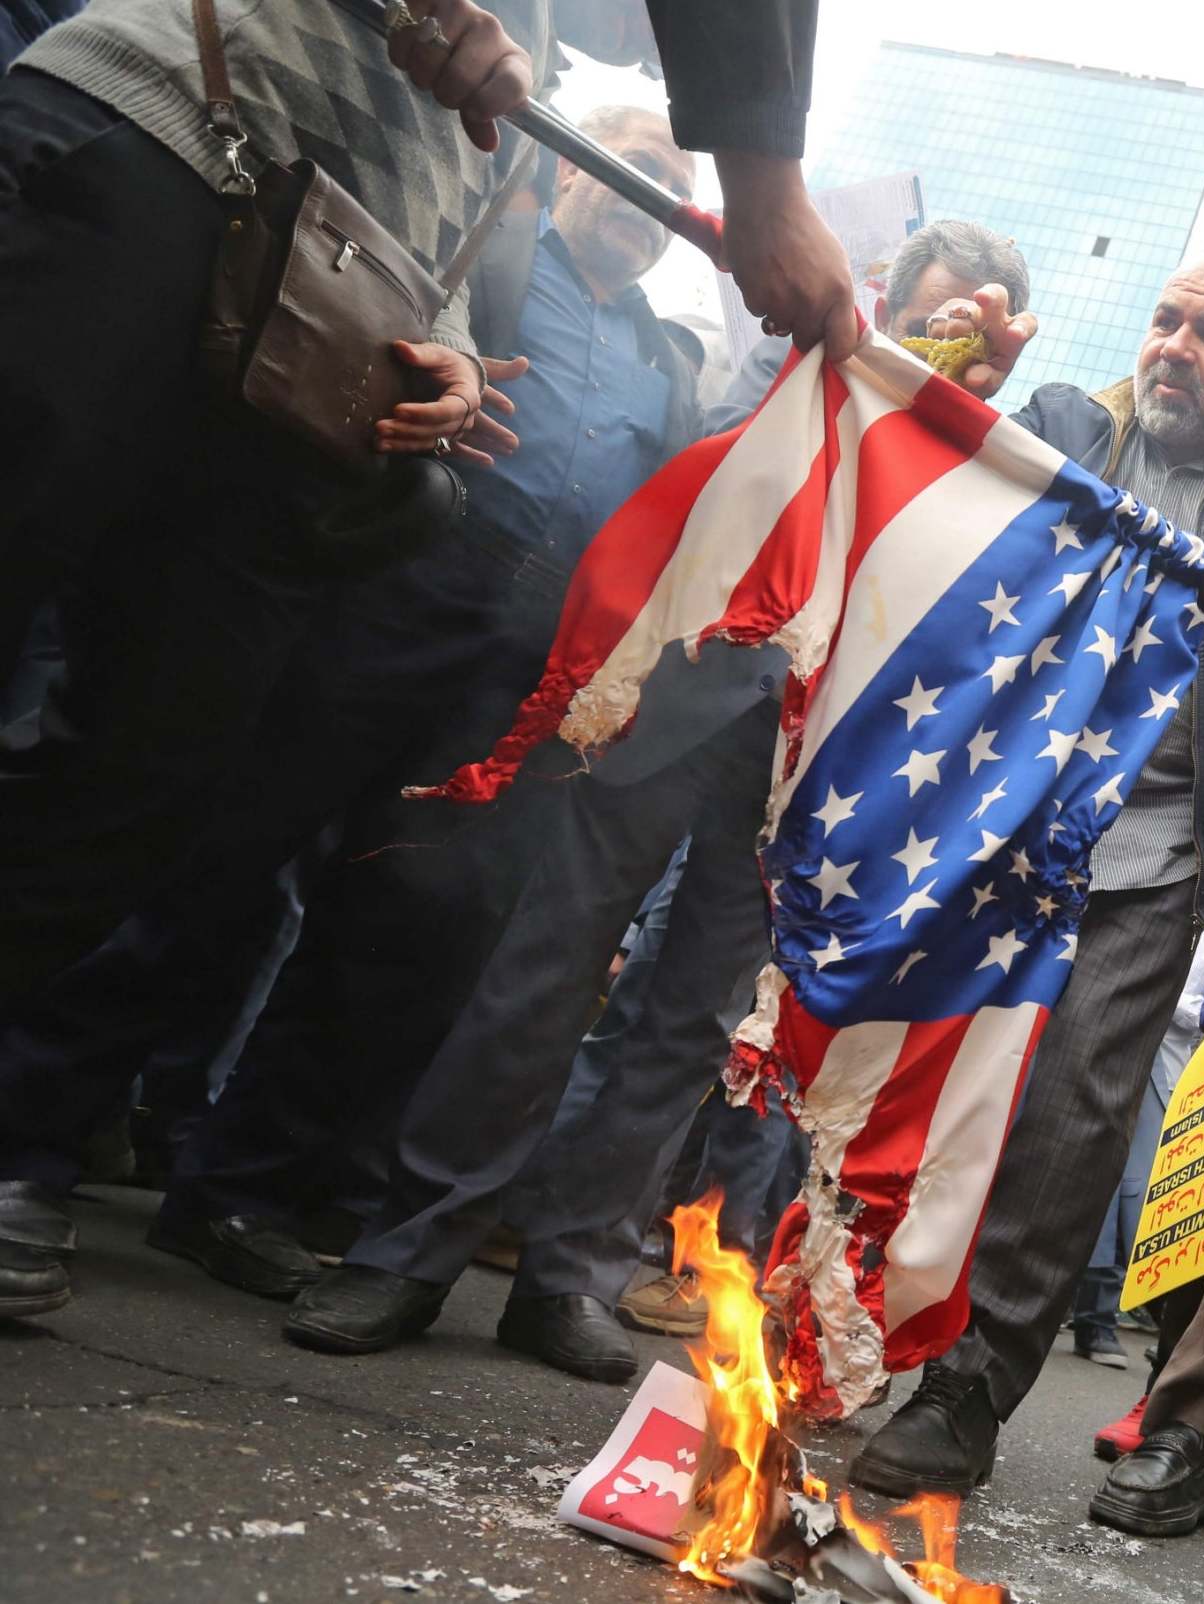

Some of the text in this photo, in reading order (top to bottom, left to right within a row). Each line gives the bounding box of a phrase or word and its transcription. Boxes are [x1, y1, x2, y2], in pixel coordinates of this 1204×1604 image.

[1170, 1112, 1203, 1138] Islam
[1160, 1133, 1204, 1175] الموت
[1151, 1168, 1192, 1199] ISRAEL
[1150, 1188, 1196, 1232] الموت
[1139, 1230, 1171, 1259] U.S.A
[1137, 1256, 1170, 1292] مرگ
[1175, 1236, 1197, 1266] بر
